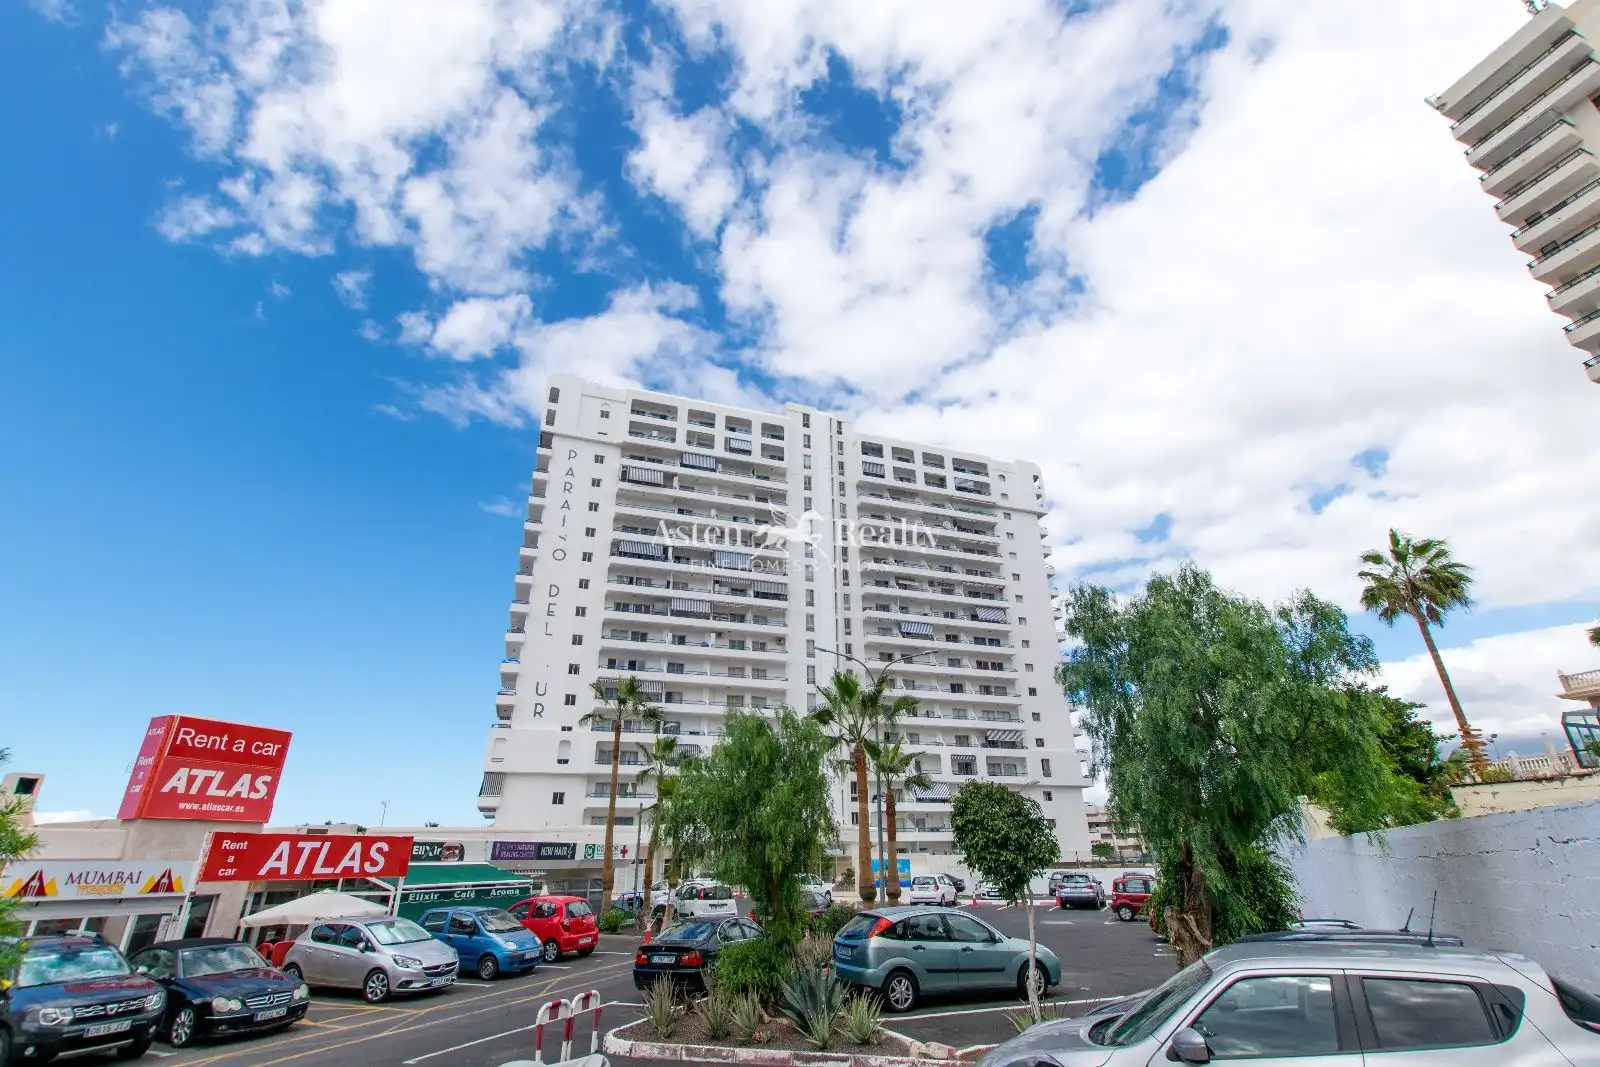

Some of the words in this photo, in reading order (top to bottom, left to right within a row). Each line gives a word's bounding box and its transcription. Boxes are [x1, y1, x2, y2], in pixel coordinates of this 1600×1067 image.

[545, 583, 560, 636] DEL
[148, 726, 165, 736] ATLAS
[176, 727, 229, 751] Rent
[232, 739, 245, 753] a
[251, 741, 282, 757] car
[138, 756, 154, 766] Rent
[130, 784, 143, 793] car
[160, 767, 273, 800] ATLAS
[178, 801, 245, 814] www.atlascar.es
[221, 839, 248, 850] Rent
[540, 846, 554, 856] NEW
[553, 846, 568, 856] HAIR
[227, 855, 235, 863] a
[257, 840, 389, 876] ATLAS
[64, 870, 143, 886] MUMBAI
[218, 867, 237, 877] car
[454, 889, 477, 900] Café
[490, 887, 520, 897] Aroma
